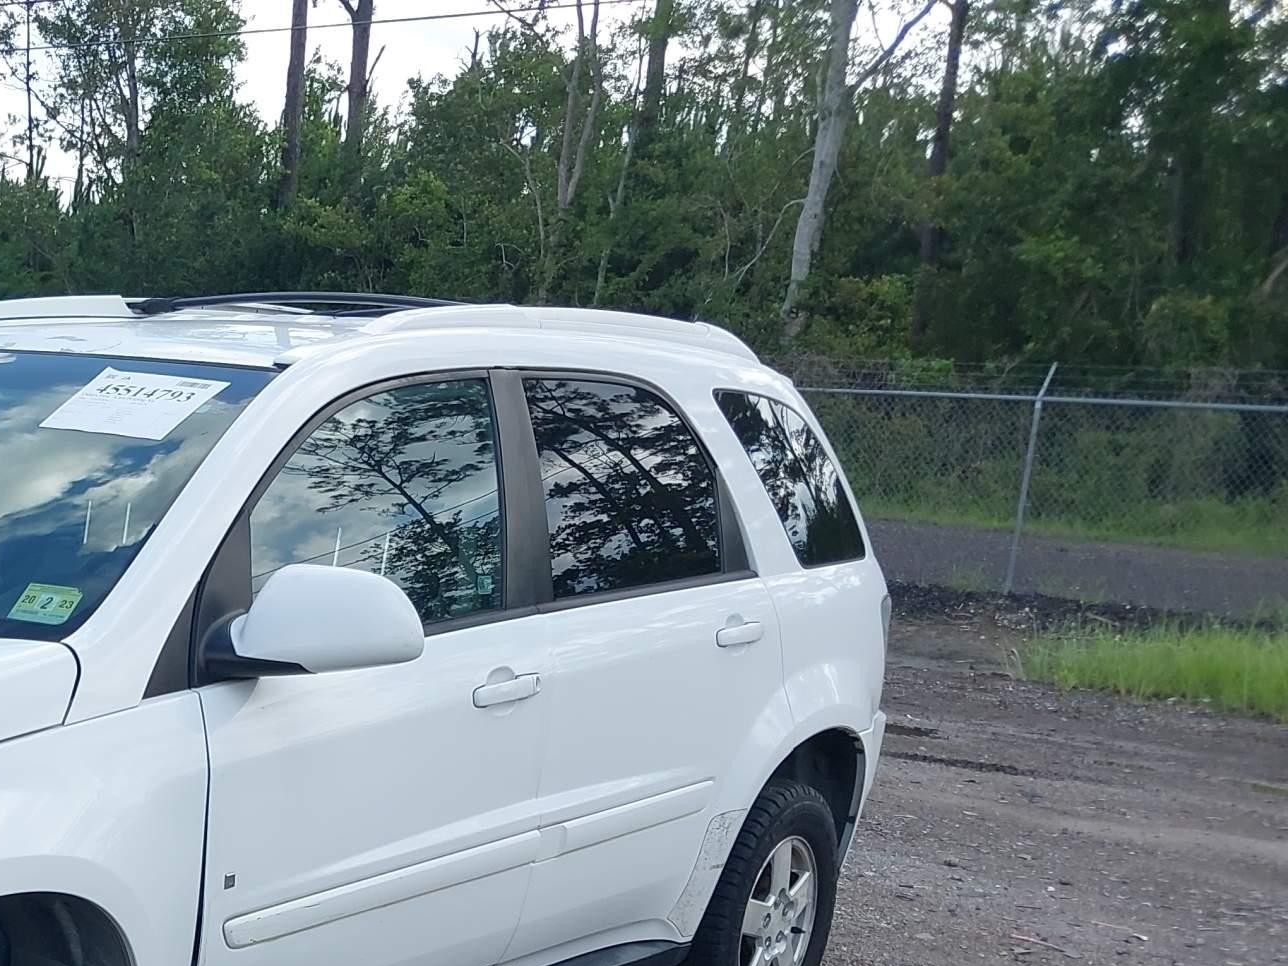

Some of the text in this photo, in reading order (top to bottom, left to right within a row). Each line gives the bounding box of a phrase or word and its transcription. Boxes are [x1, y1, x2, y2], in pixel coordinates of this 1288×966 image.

[96, 383, 196, 402] 45514793
[21, 594, 75, 610] 20 2 23
